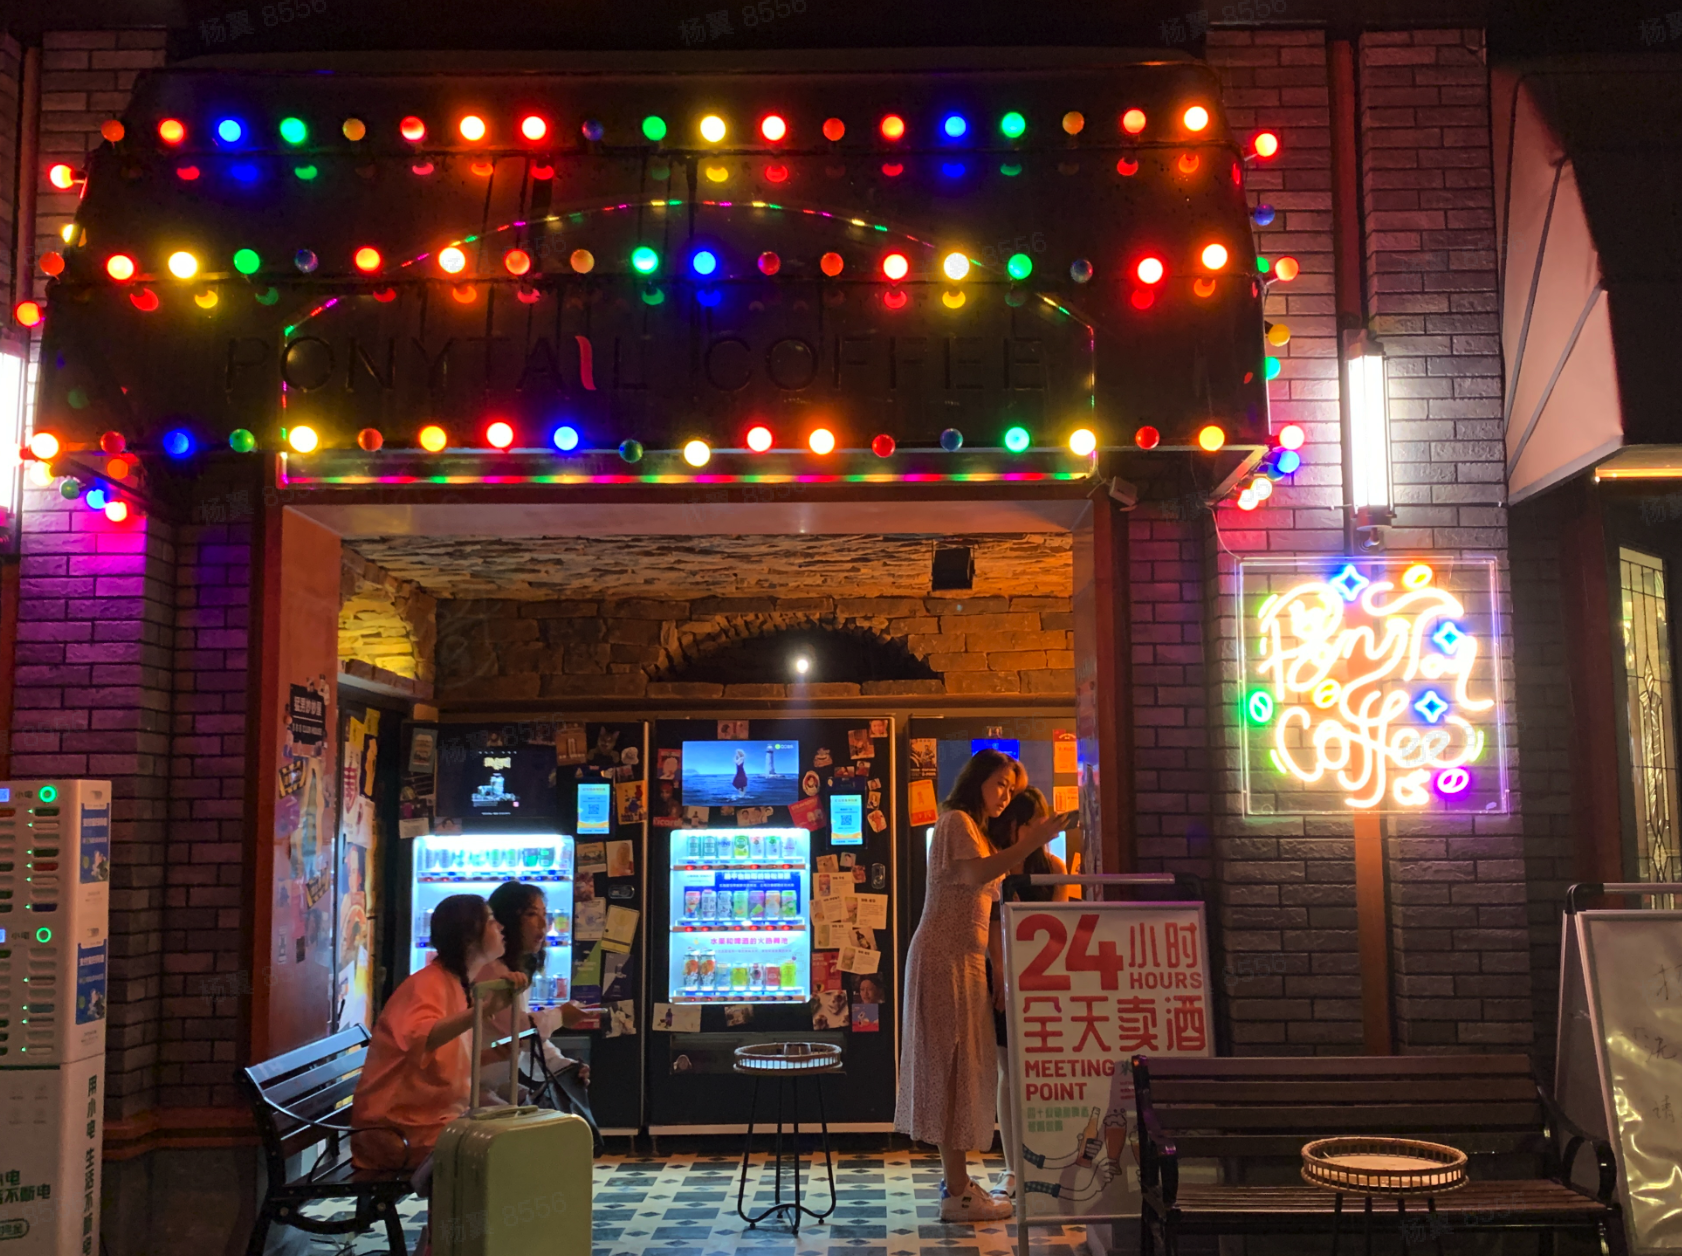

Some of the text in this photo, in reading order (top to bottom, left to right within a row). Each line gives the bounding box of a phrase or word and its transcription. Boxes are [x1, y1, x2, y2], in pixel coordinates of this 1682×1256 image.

[224, 334, 1048, 393] PONYTAIL COFFEE
[1016, 913, 1198, 992] 24 小时
[1130, 971, 1203, 990] HOURS
[1024, 994, 1207, 1054] 全天卖酒
[1025, 1059, 1116, 1078] MEETING
[86, 1074, 98, 1140] 用小电
[1025, 1082, 1088, 1102] POINT
[0, 1183, 51, 1205] 不断电
